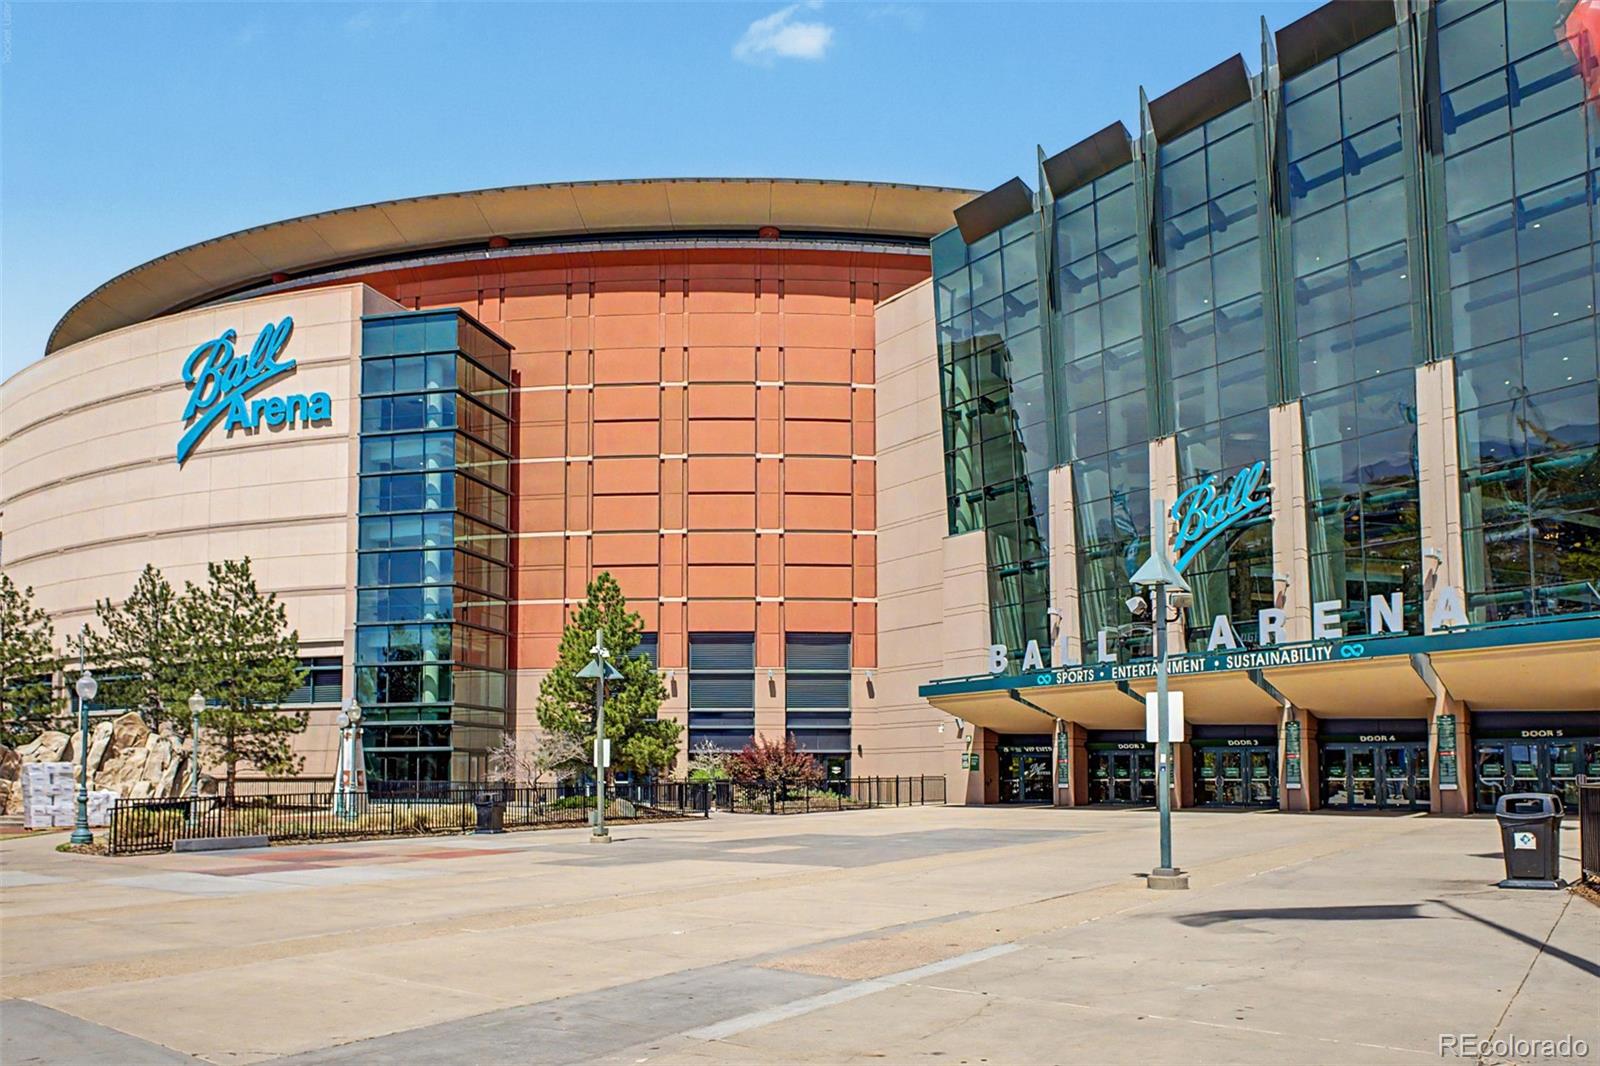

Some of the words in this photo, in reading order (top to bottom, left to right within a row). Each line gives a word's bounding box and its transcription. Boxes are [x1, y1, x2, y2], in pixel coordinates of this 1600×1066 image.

[177, 316, 296, 464] Ball
[224, 391, 332, 431] Arena
[1171, 460, 1269, 573] Ball
[988, 630, 1118, 675] BALL
[1207, 585, 1470, 651] ARENA
[1056, 669, 1095, 684] SPORTS
[1111, 658, 1206, 679] ENTERTANMENT
[1226, 646, 1333, 669] SUSTAINABILITY
[1522, 730, 1554, 738] DOOR
